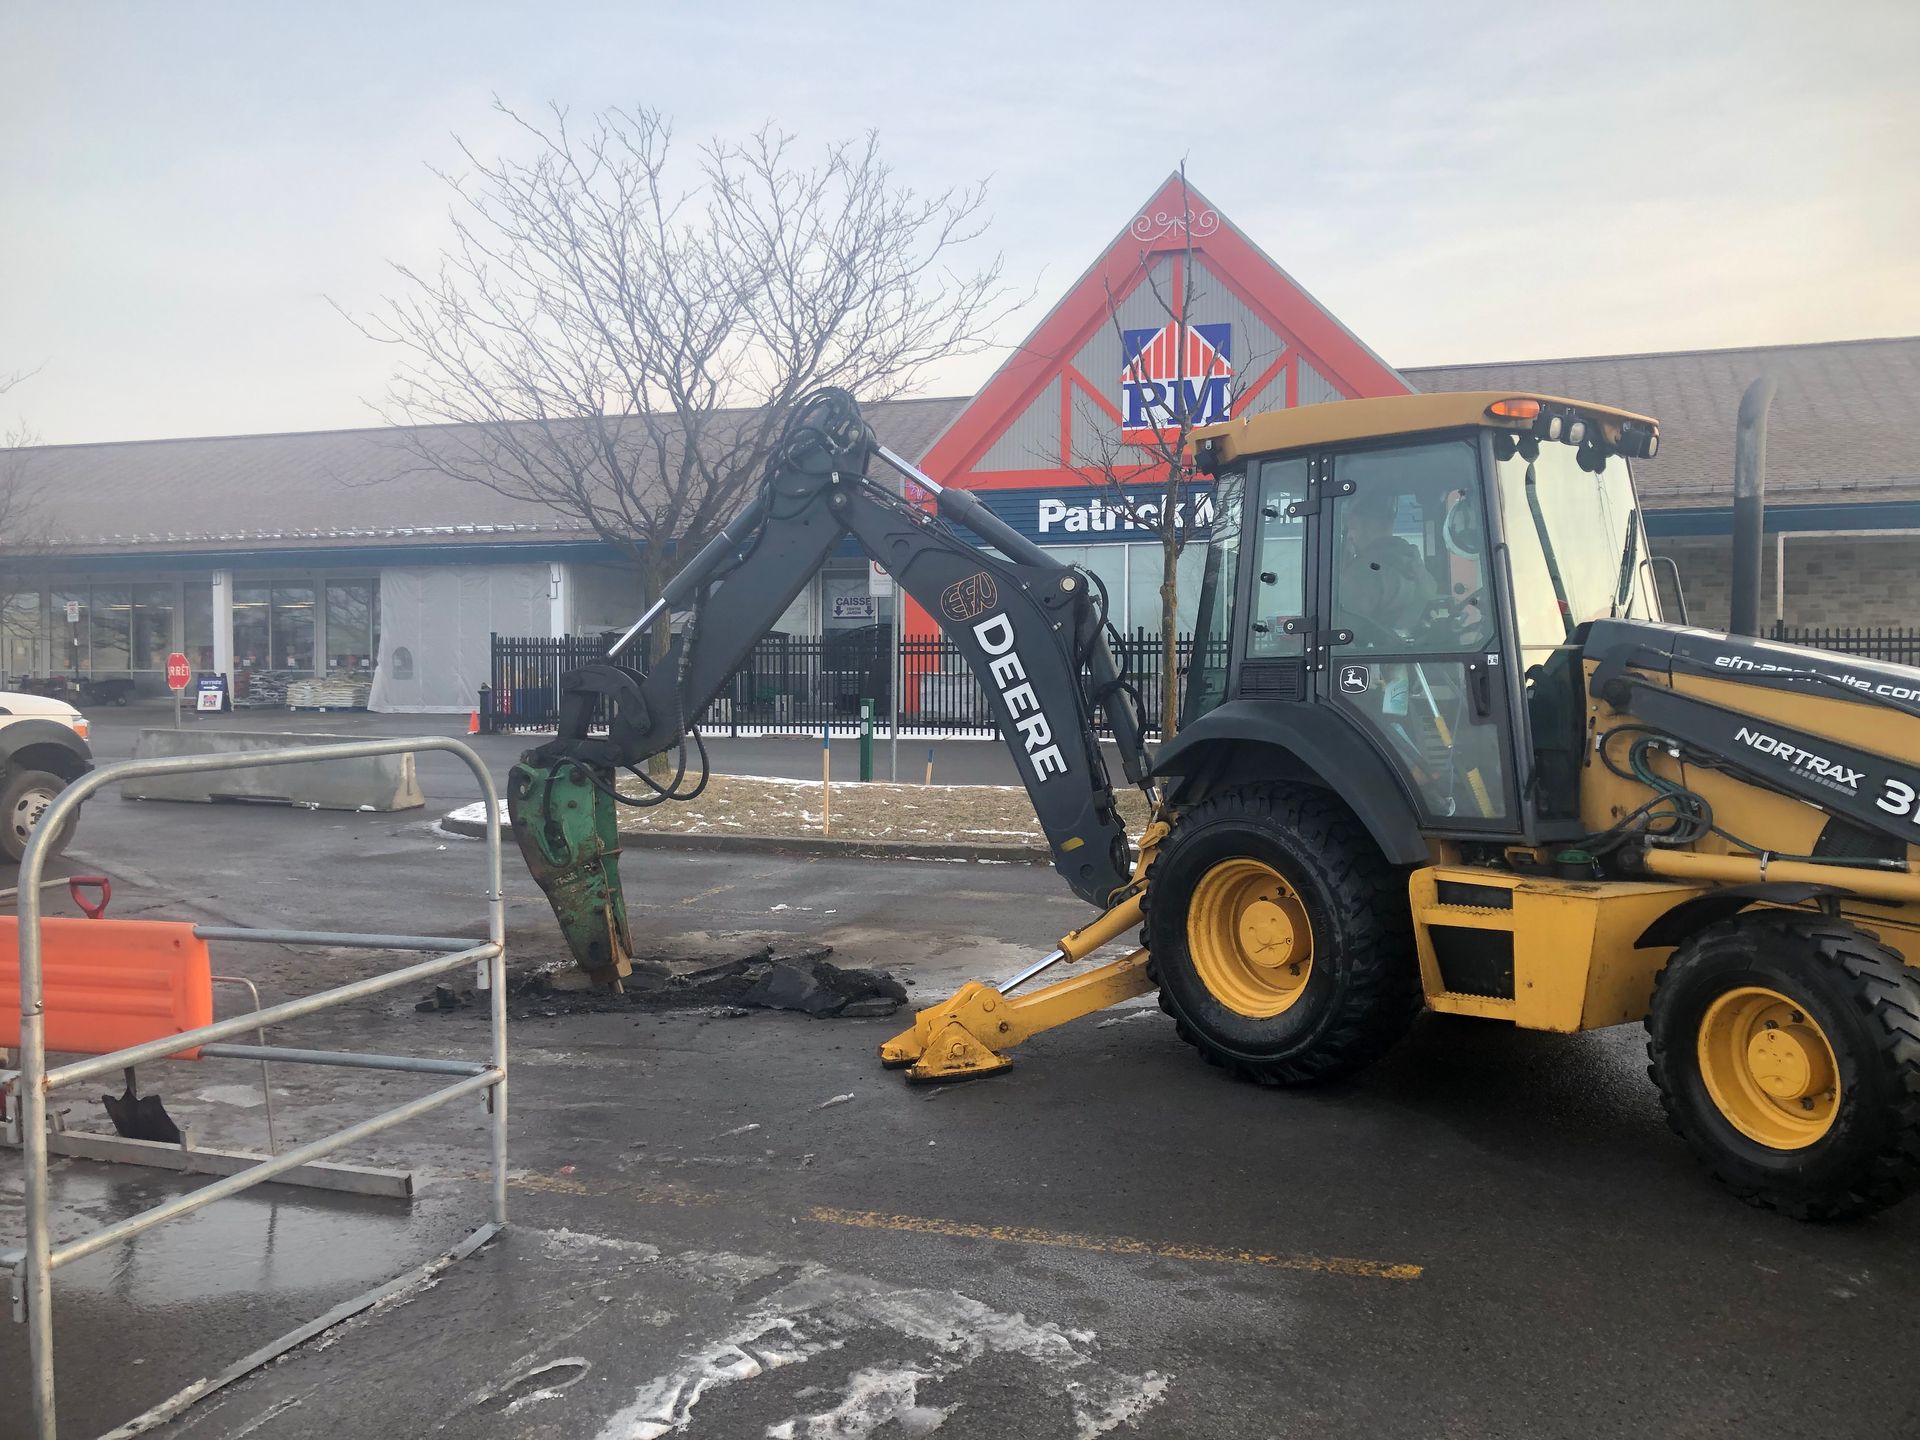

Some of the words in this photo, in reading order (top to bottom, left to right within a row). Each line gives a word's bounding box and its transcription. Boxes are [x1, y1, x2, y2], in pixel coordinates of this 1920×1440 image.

[1039, 494, 1186, 533] Patrick
[835, 597, 872, 606] CAISSE
[168, 664, 189, 676] RRÊT
[973, 612, 1068, 783] DEERE
[1734, 727, 1866, 788] NORTRAX
